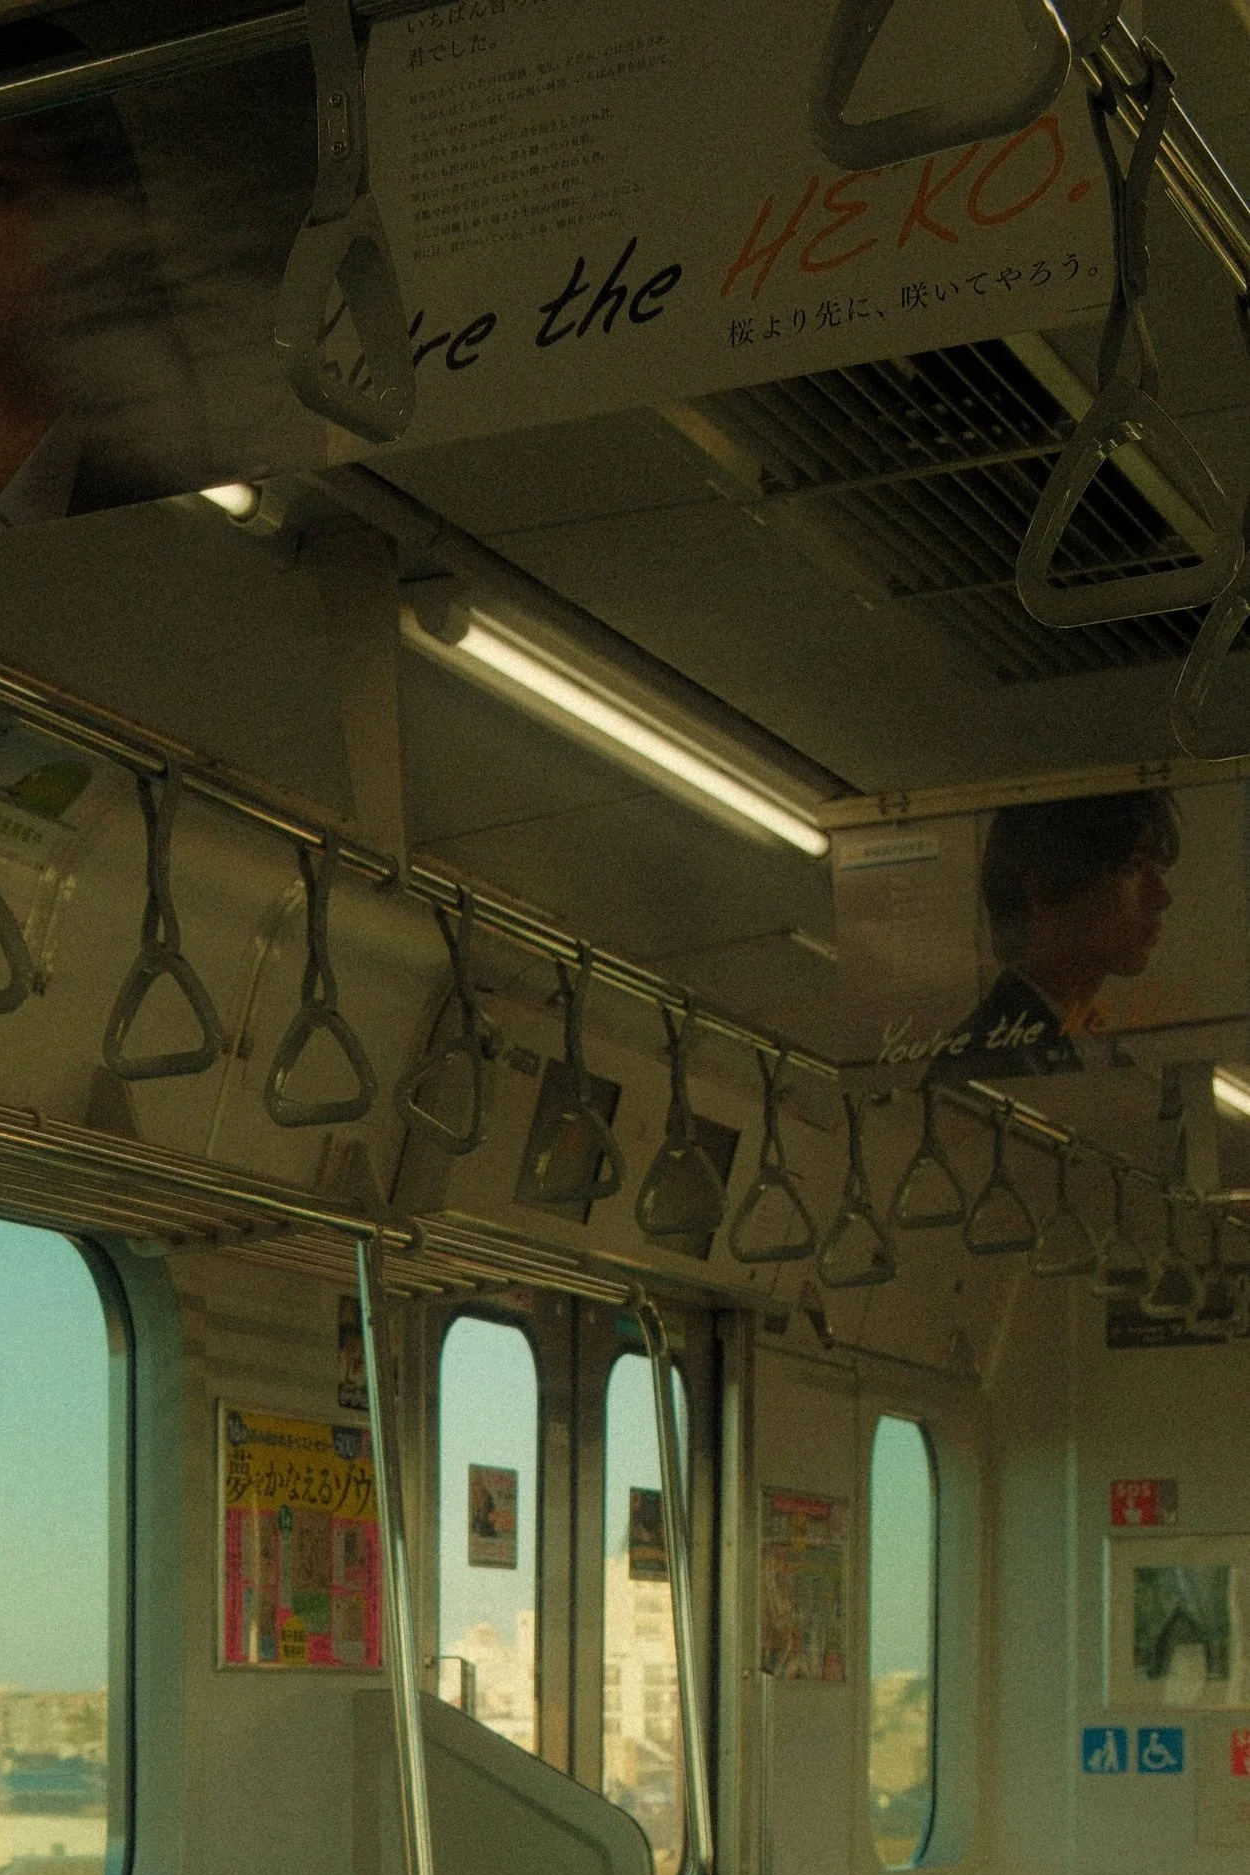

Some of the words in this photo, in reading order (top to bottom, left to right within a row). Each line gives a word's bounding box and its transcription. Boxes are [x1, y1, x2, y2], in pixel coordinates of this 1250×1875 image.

[410, 34, 497, 71] 君でした。
[538, 237, 682, 350] the
[728, 254, 1101, 349] 桜より先に、咲いてやろう。
[878, 1015, 971, 1065] You're
[986, 1011, 1045, 1048] the
[1116, 1483, 1152, 1498] SOS
